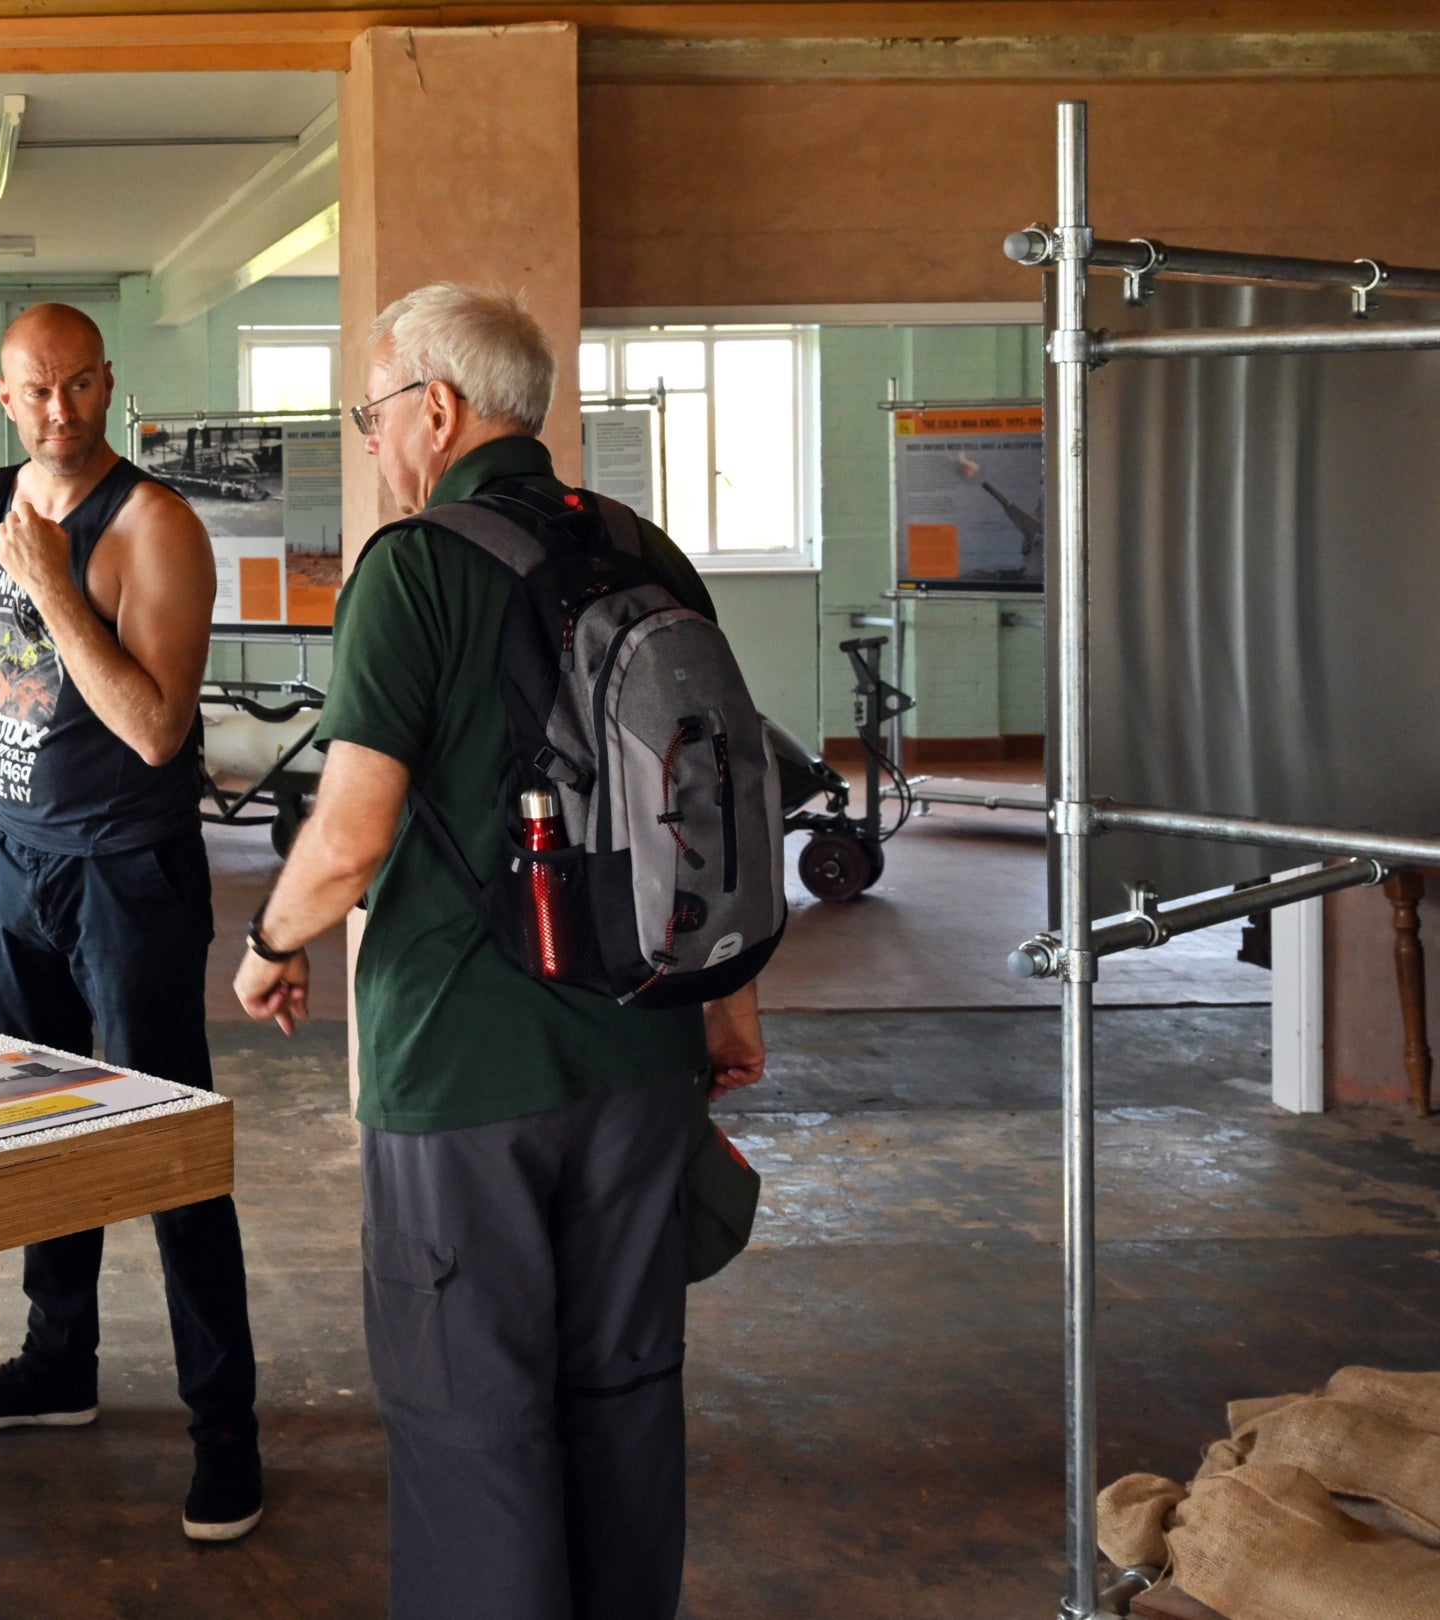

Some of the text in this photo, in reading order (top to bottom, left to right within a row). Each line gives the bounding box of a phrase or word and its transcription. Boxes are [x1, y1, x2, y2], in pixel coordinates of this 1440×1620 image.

[3, 598, 33, 614] PECE
[0, 758, 32, 785] 1969
[10, 784, 32, 803] NY
